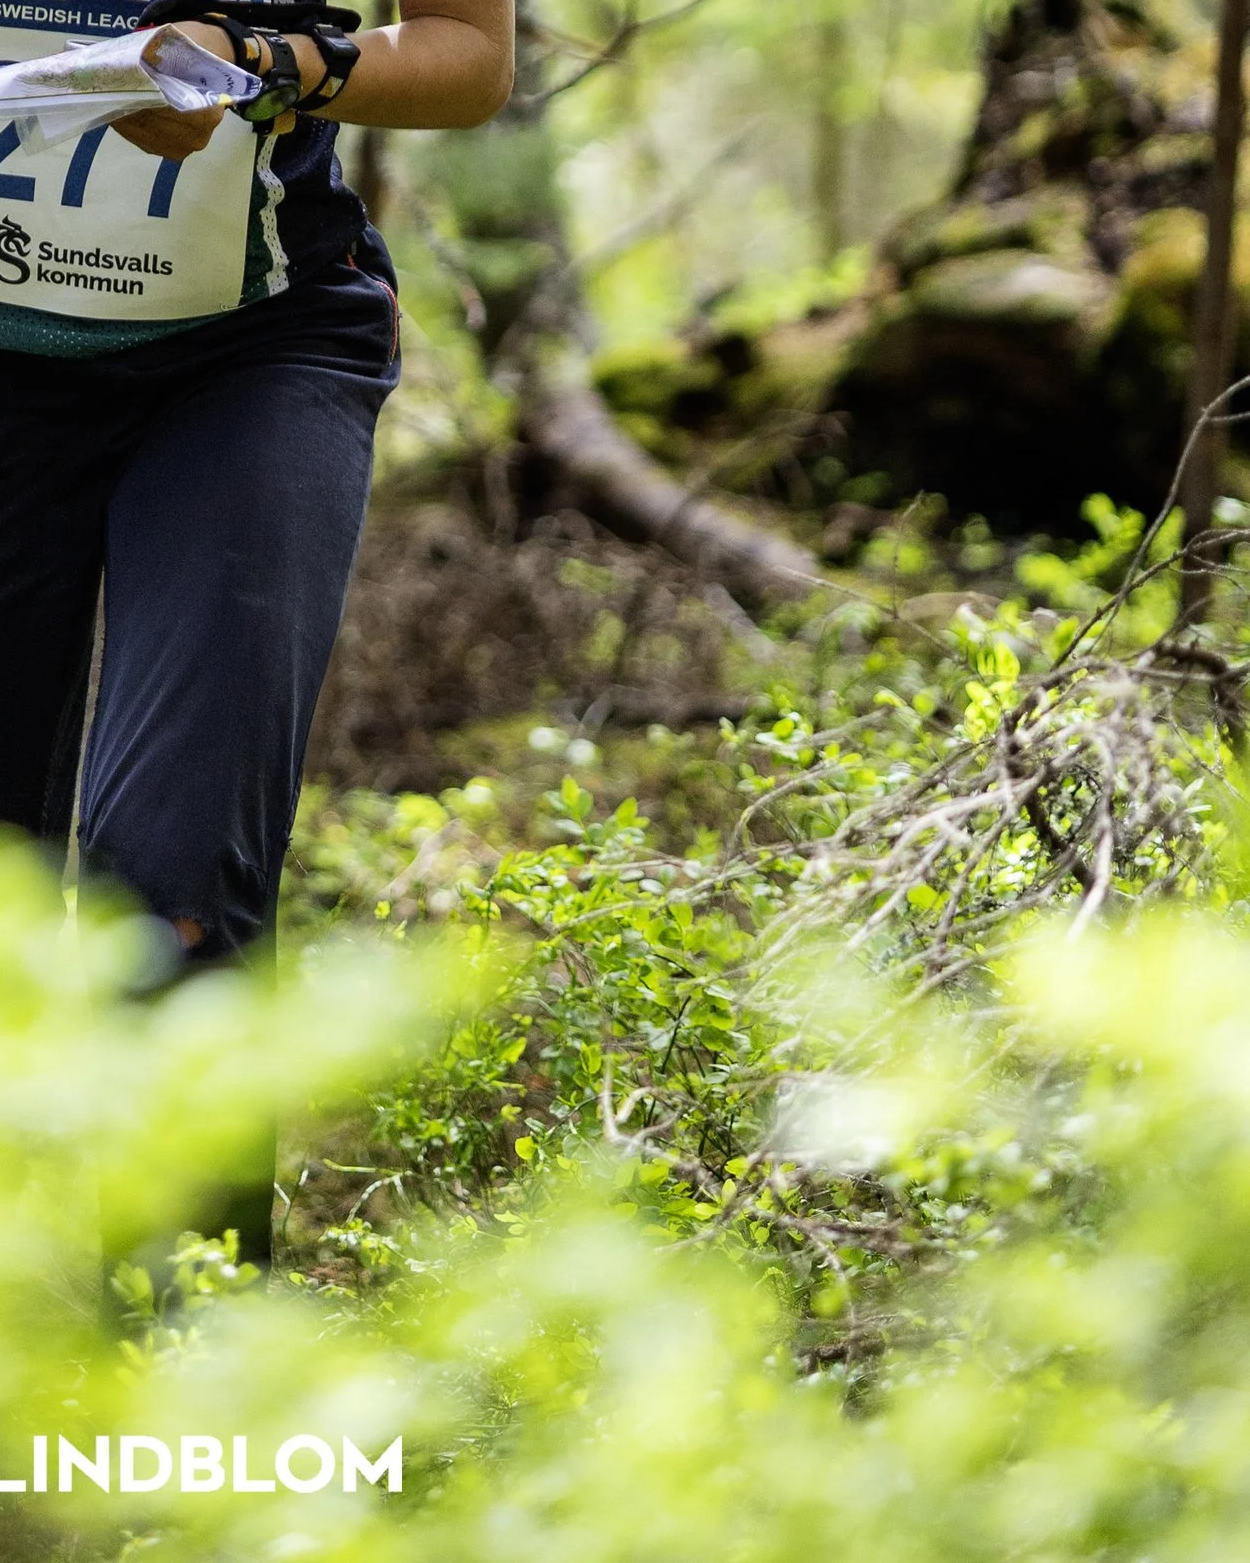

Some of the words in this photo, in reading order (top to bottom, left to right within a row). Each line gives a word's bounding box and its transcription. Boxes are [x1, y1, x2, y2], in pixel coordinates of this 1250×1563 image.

[87, 12, 139, 30] LEAG
[37, 241, 173, 276] Sundsvalls
[36, 263, 144, 295] kommun
